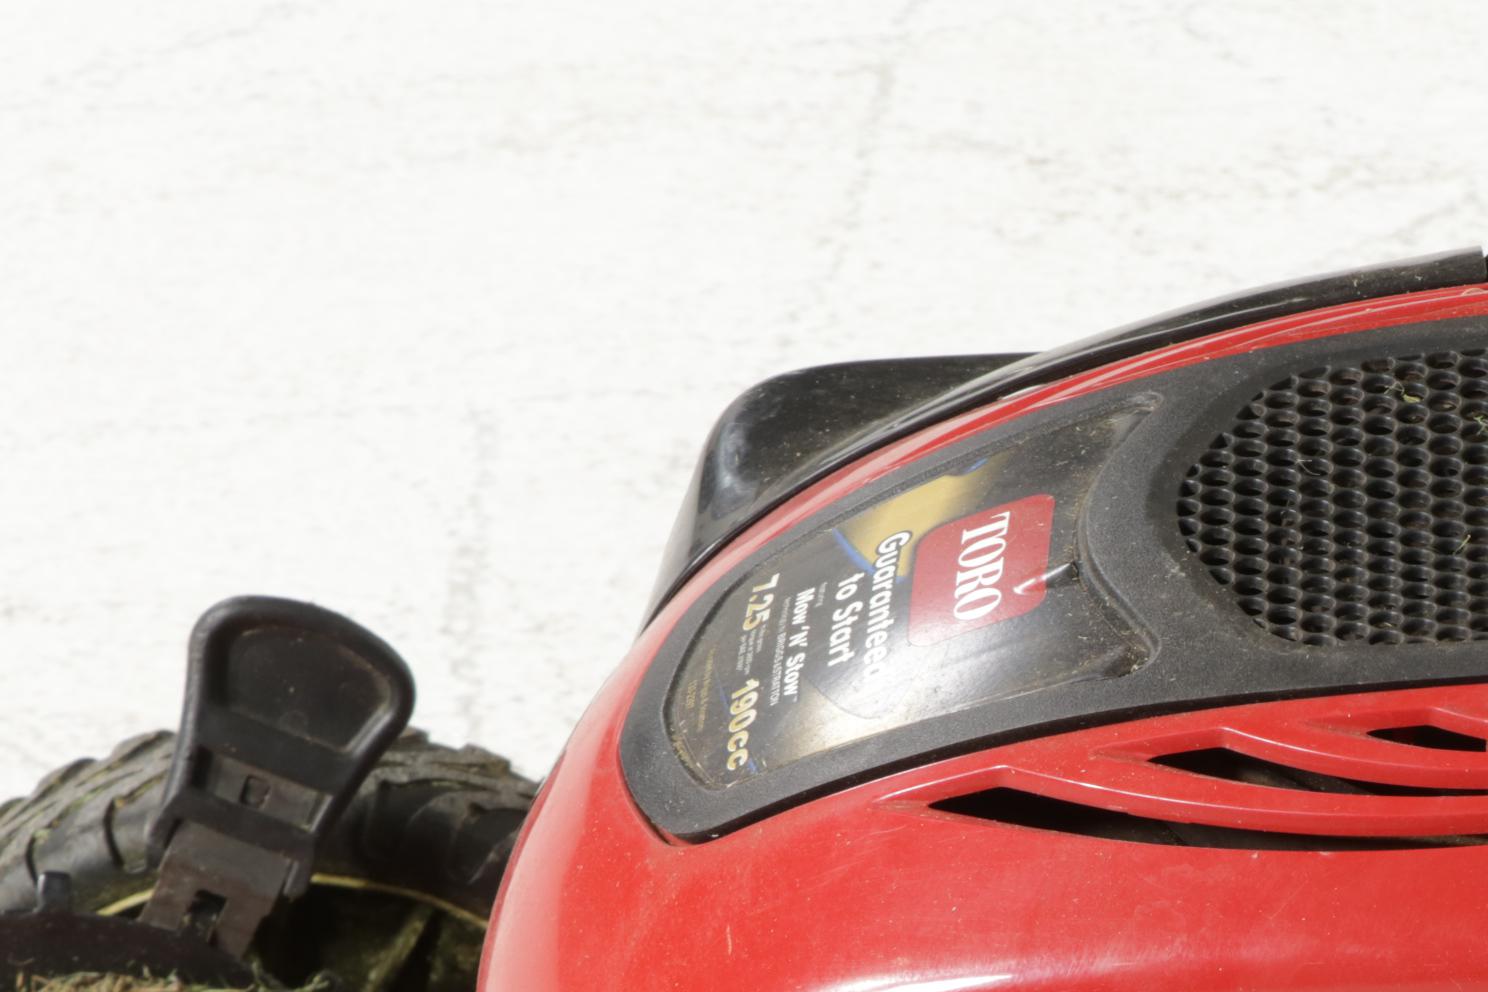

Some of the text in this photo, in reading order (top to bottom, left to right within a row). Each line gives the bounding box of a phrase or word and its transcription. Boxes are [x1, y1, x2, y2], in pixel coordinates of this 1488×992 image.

[742, 572, 781, 632] 7.25
[792, 587, 816, 625] Mow
[953, 510, 1011, 621] TORO
[827, 572, 865, 667] to Start
[726, 678, 760, 771] 190cc
